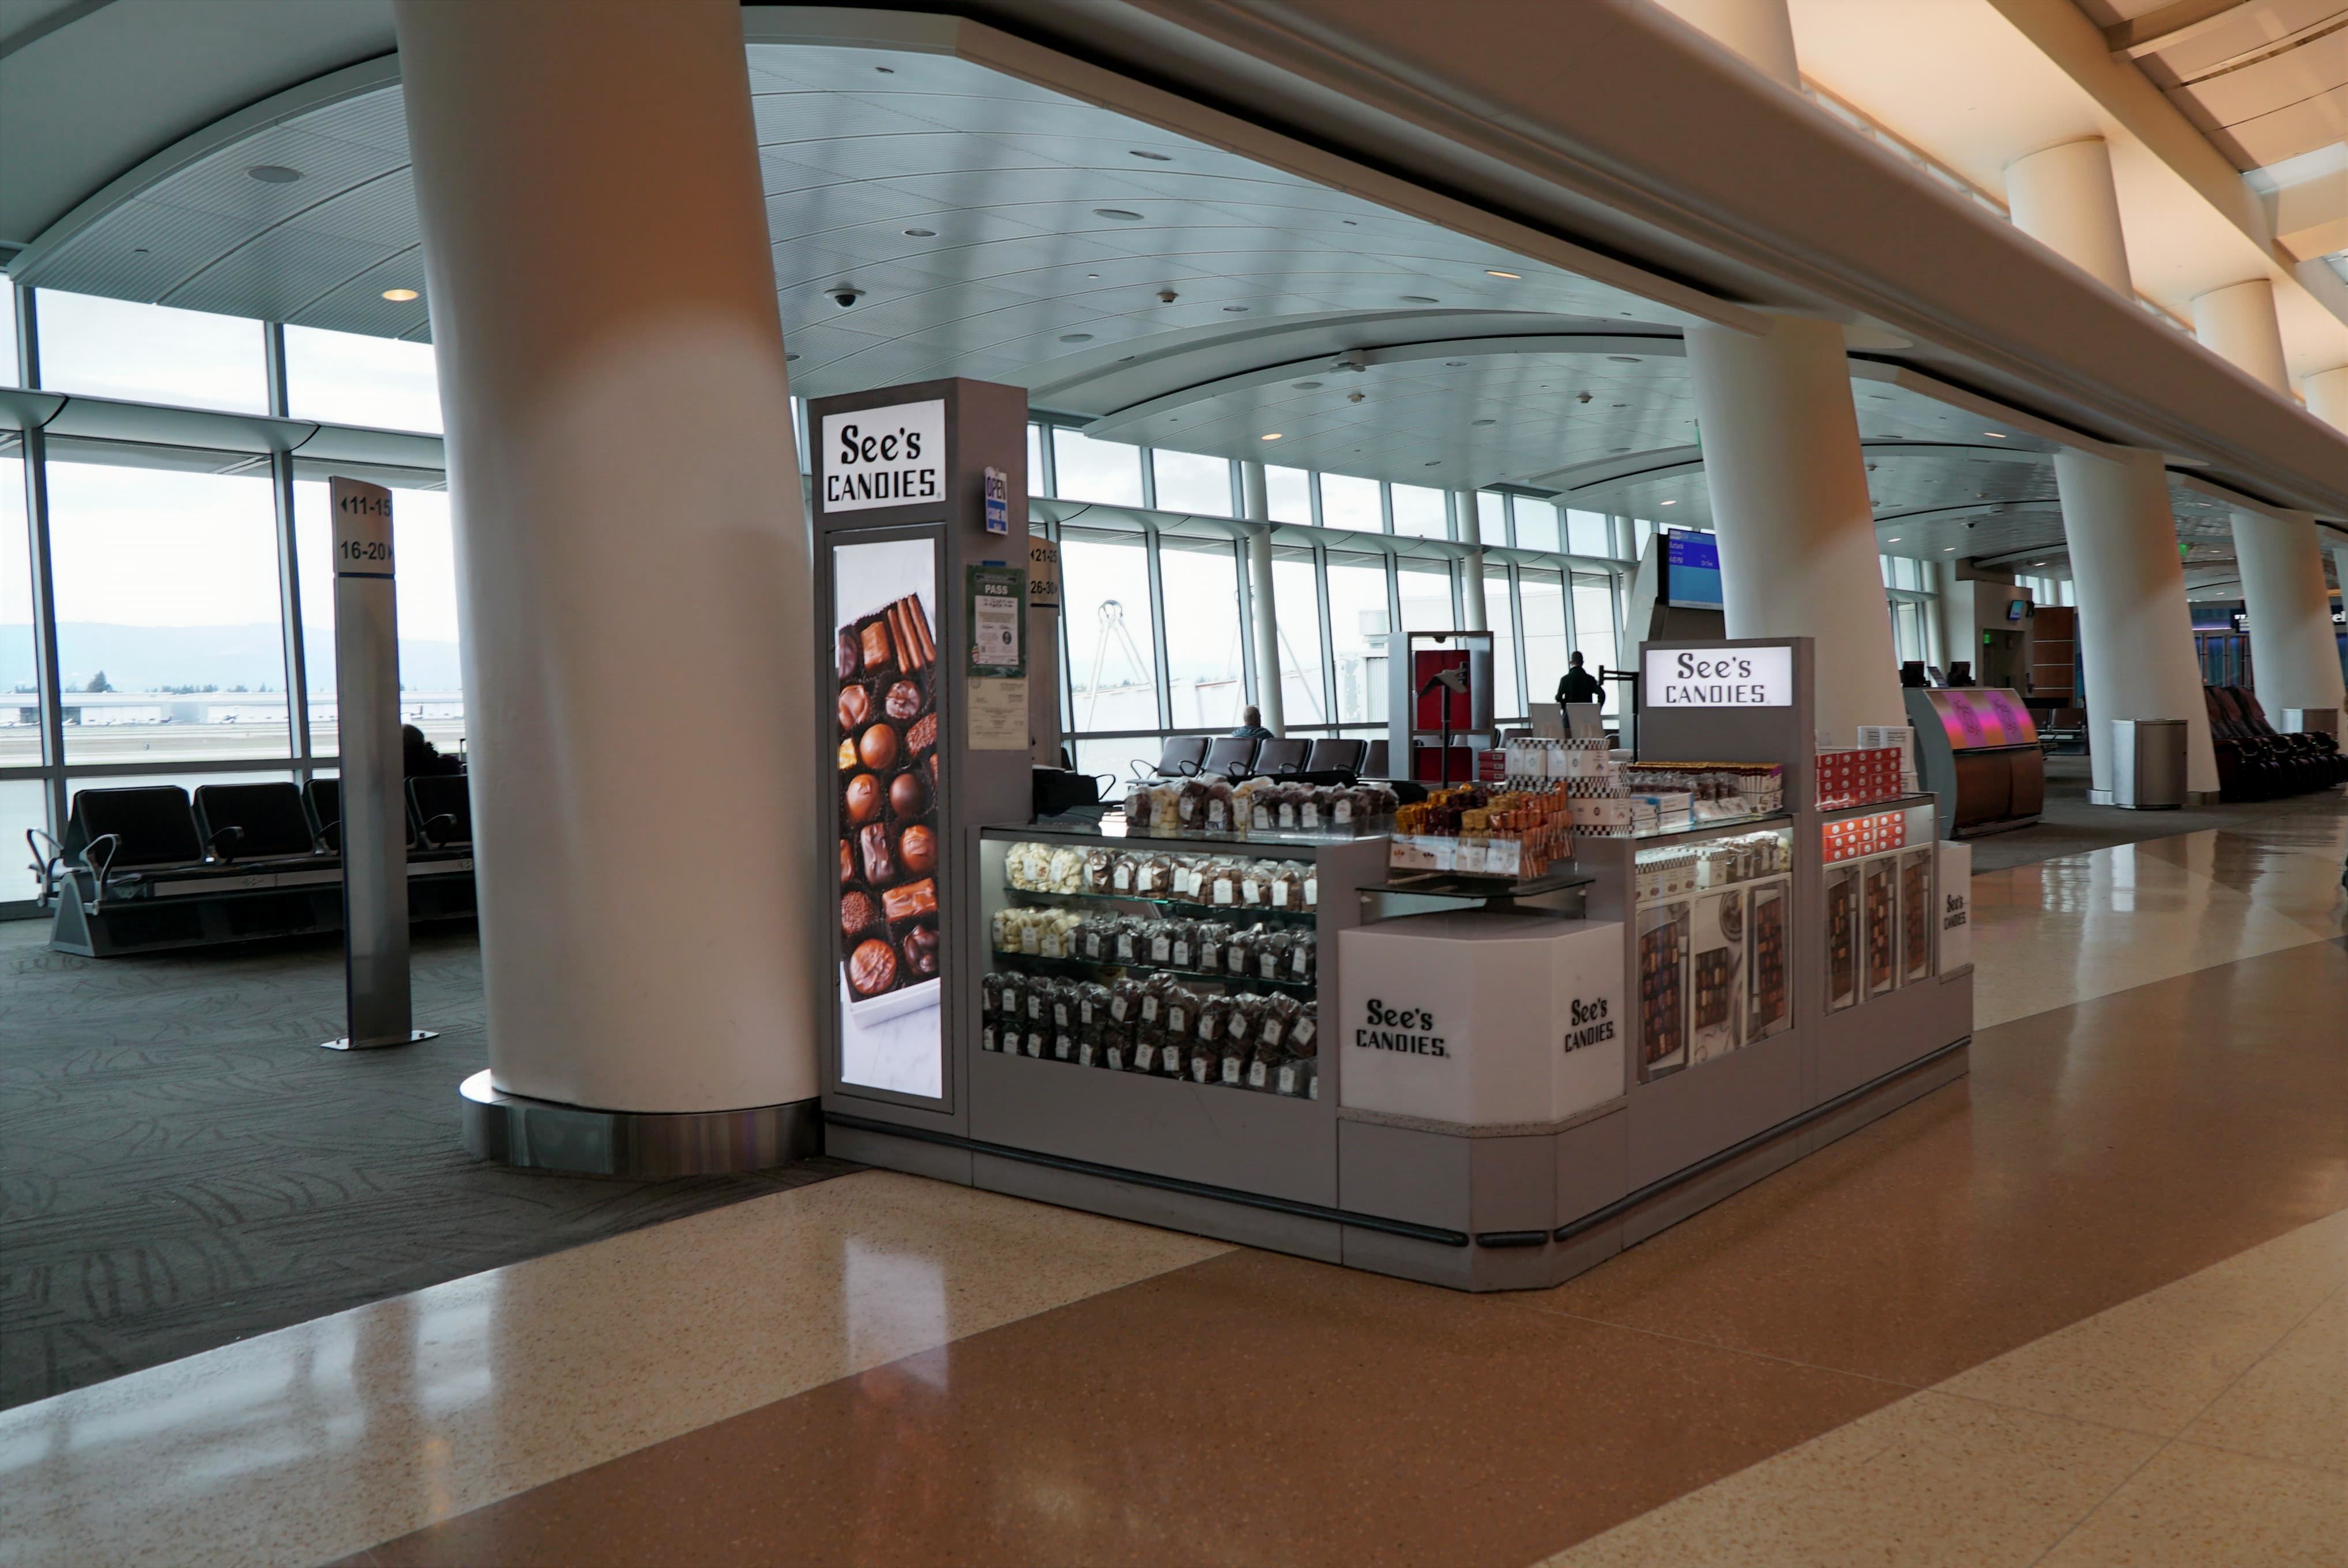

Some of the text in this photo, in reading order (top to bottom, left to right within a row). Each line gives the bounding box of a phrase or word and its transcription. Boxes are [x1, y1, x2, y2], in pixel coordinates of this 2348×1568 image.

[841, 424, 921, 464] See's
[828, 469, 935, 502] CANDIES
[987, 476, 1006, 500] OPEN
[350, 496, 391, 517] 11-15
[340, 541, 386, 560] 16-20
[1035, 548, 1057, 563] 21-25
[985, 584, 1009, 595] PASS
[2330, 611, 2346, 623] el
[1677, 653, 1751, 679] See's
[1666, 685, 1764, 703] CANDIES
[1367, 999, 1432, 1031] See's
[1571, 997, 1608, 1026] See's
[1356, 1029, 1444, 1057] CANDIES
[1564, 1020, 1613, 1052] CANDIES
